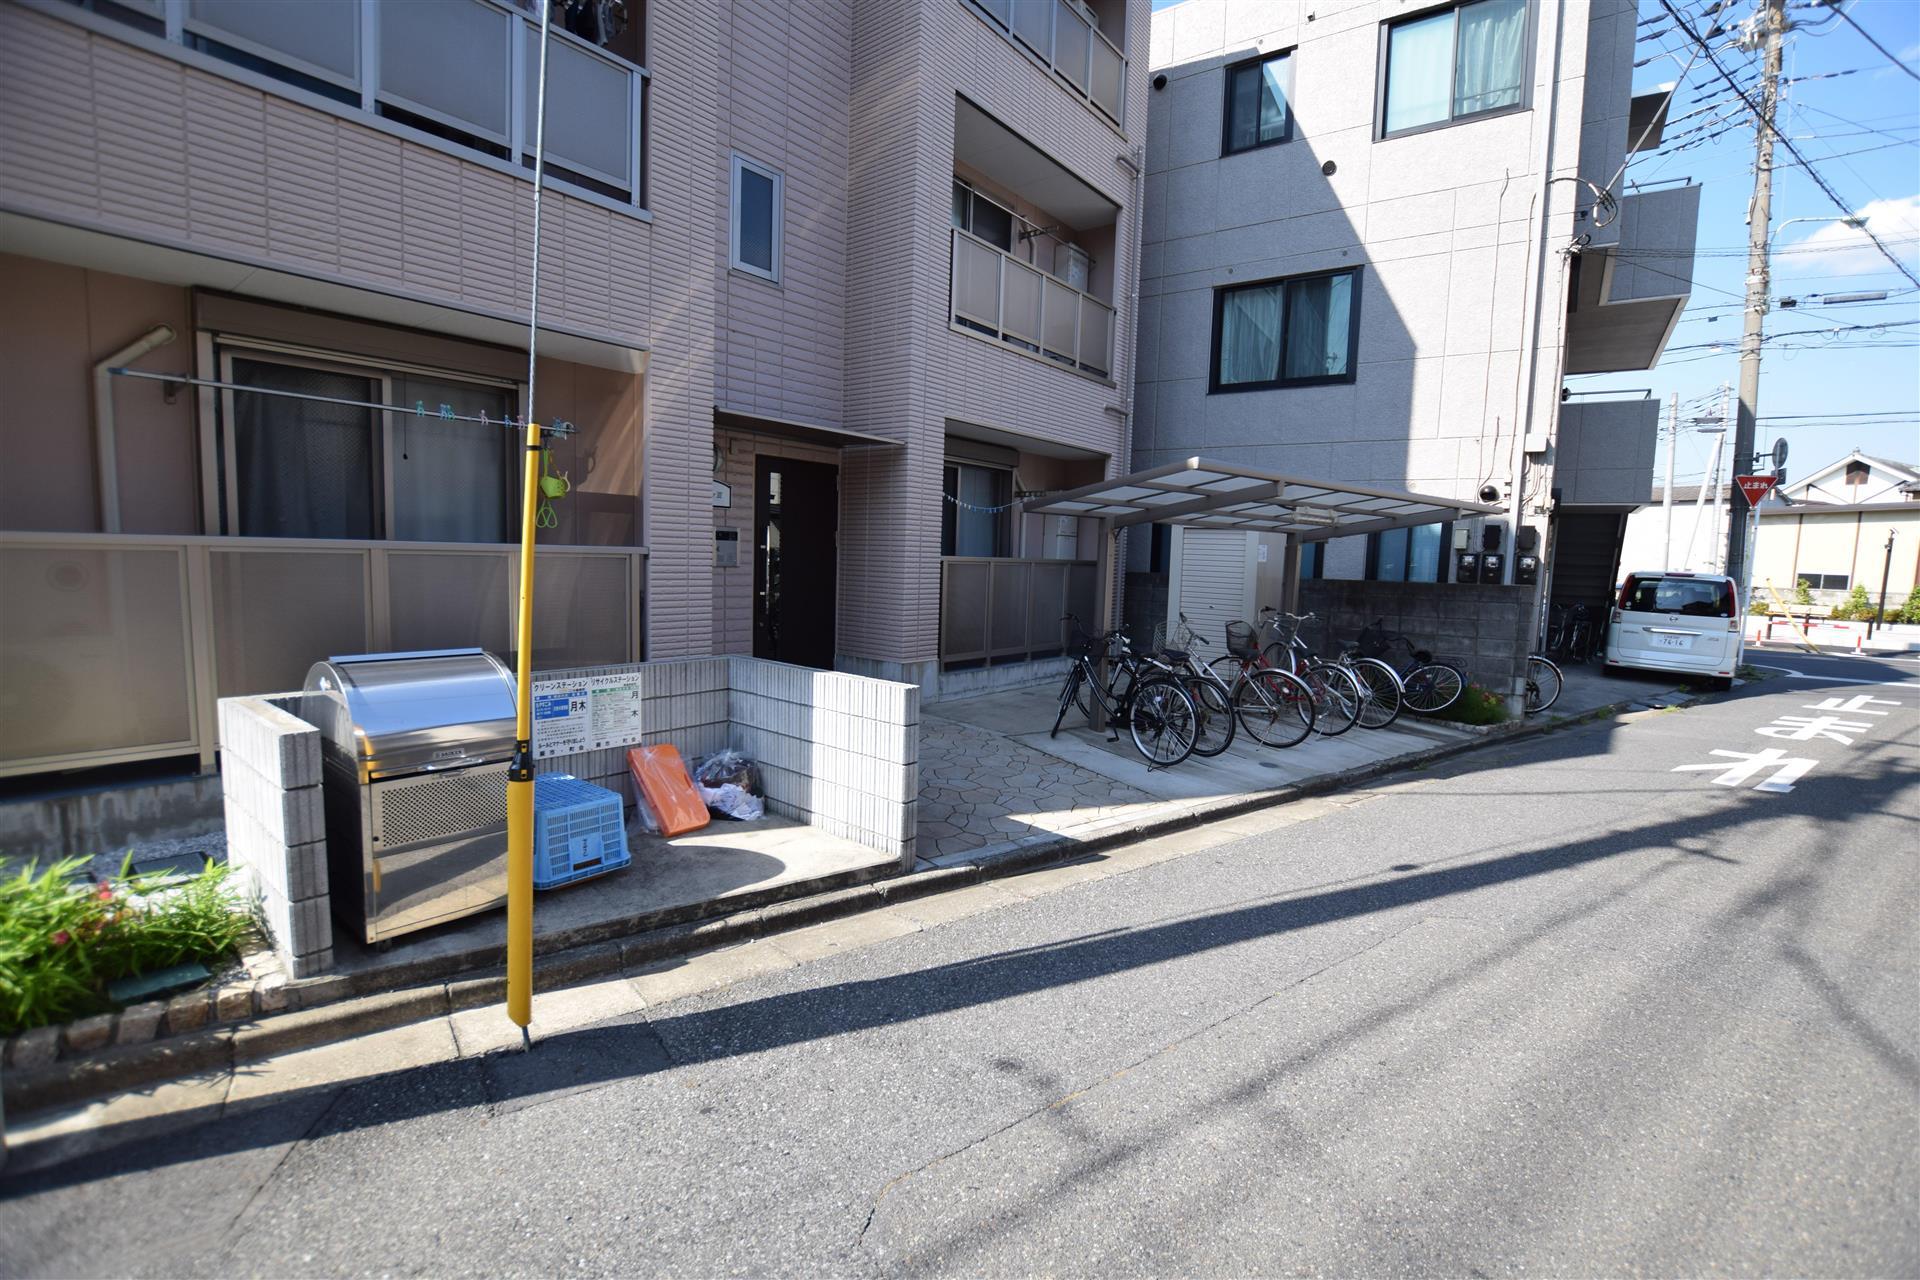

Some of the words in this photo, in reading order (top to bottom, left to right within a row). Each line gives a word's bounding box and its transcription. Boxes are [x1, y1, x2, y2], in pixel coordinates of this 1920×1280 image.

[1744, 481, 1769, 490] 止まれ
[591, 676, 639, 686] リサイクルステーション
[534, 681, 588, 692] クリーンステーション
[631, 691, 639, 699] 月
[570, 700, 586, 712] 月木
[631, 710, 639, 718] 木
[1671, 695, 1902, 793] 止まれ
